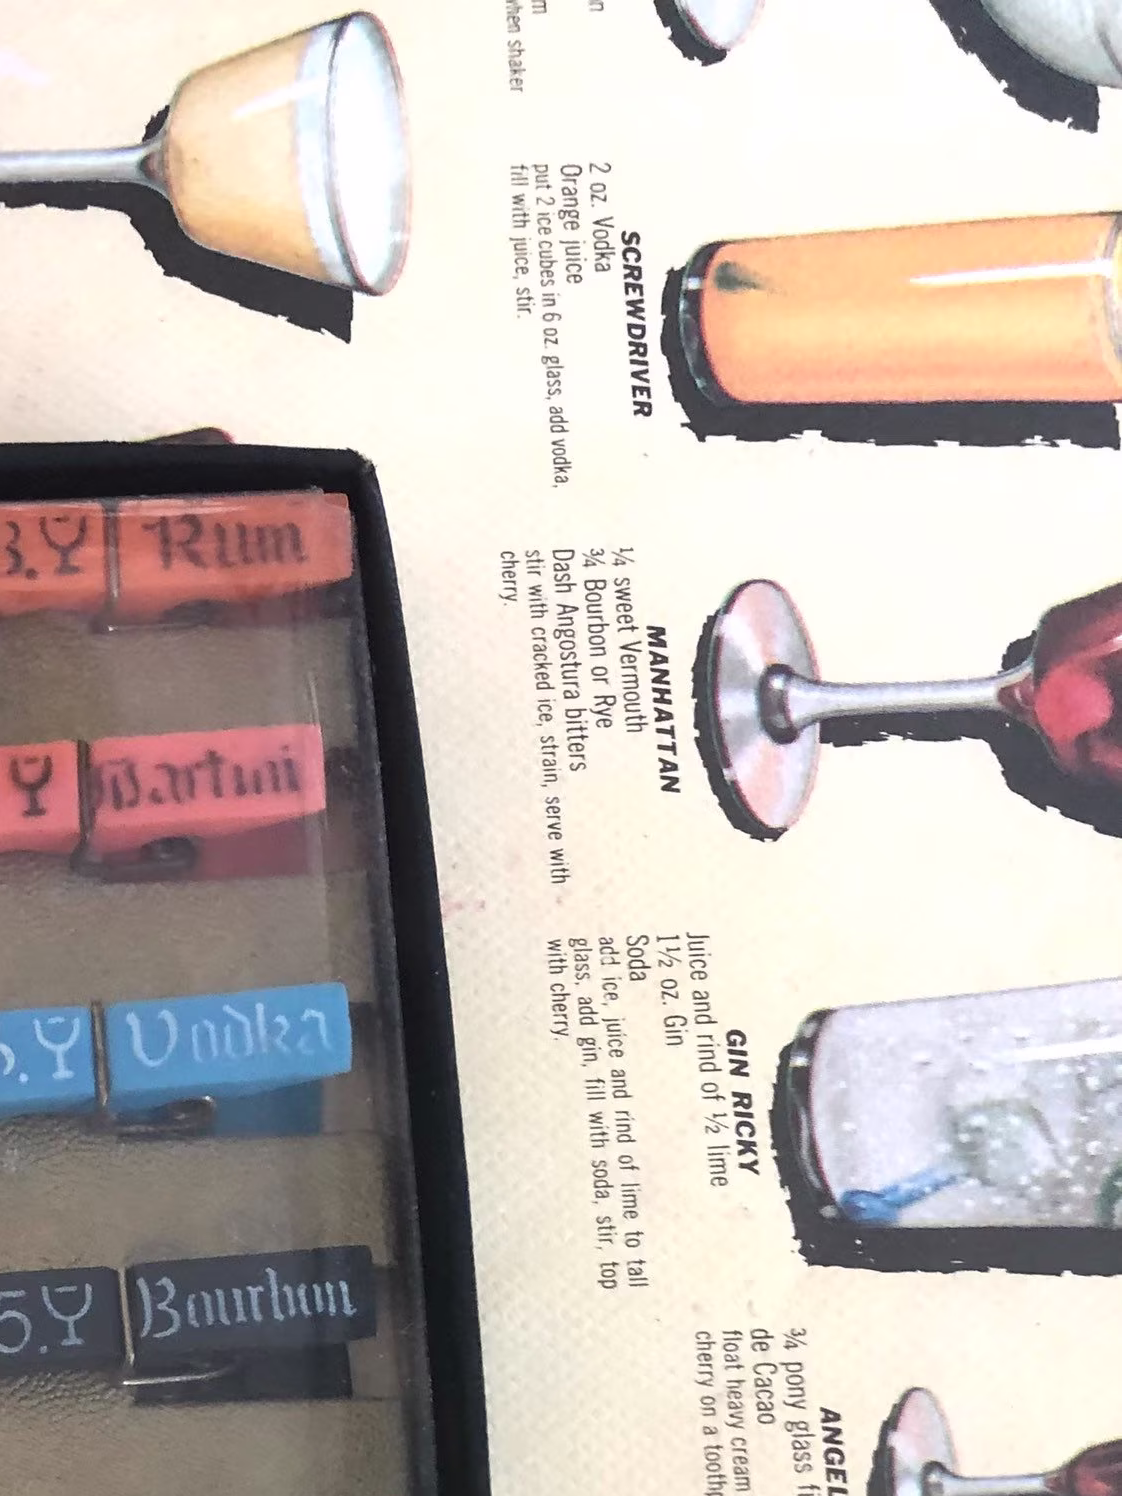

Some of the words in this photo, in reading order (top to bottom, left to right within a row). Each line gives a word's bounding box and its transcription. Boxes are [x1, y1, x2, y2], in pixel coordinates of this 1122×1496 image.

[531, 164, 552, 190] put
[558, 164, 582, 230] Orange
[536, 212, 554, 236] ice
[592, 217, 616, 272] Vodka
[538, 240, 558, 287] cubes
[559, 240, 585, 284] juice
[621, 230, 653, 417] SCREWDRIVER
[549, 406, 570, 433] add
[141, 511, 311, 571] Rum
[524, 550, 546, 576] stir
[552, 549, 577, 593] Dash
[528, 584, 548, 618] with
[584, 579, 610, 656] Bourbon
[613, 578, 640, 632] sweet
[531, 627, 556, 690] cracked
[552, 604, 582, 700] Angostura
[618, 642, 646, 732] Vermouth
[589, 695, 616, 728] Rye
[646, 626, 681, 793] MANHATTAN
[564, 708, 589, 772] bitters
[544, 796, 562, 840] serve
[550, 848, 570, 884] with
[546, 939, 568, 974] with
[626, 934, 652, 981] Soda
[686, 932, 710, 980] Juice
[692, 990, 718, 1024] and
[126, 1002, 334, 1068] Vodka
[601, 1018, 627, 1058] juice
[663, 1015, 688, 1048] Gin
[696, 1034, 722, 1072] rind
[726, 1029, 750, 1078] GIN
[584, 1078, 606, 1100] fill
[610, 1069, 634, 1098] and
[588, 1112, 610, 1148] with
[614, 1110, 637, 1143] rind
[731, 1091, 760, 1176] RICKY
[707, 1146, 728, 1186] lime
[620, 1184, 640, 1220] lime
[597, 1262, 620, 1290] top
[626, 1258, 650, 1287] tall
[137, 1266, 359, 1340] Bourbon
[694, 1331, 716, 1387] cherry
[722, 1330, 745, 1370] float
[750, 1328, 774, 1352] de
[724, 1380, 746, 1430] heavy
[752, 1362, 776, 1424] Cacao
[780, 1362, 806, 1410] pony
[730, 1437, 751, 1492] cream
[786, 1420, 816, 1474] glass
